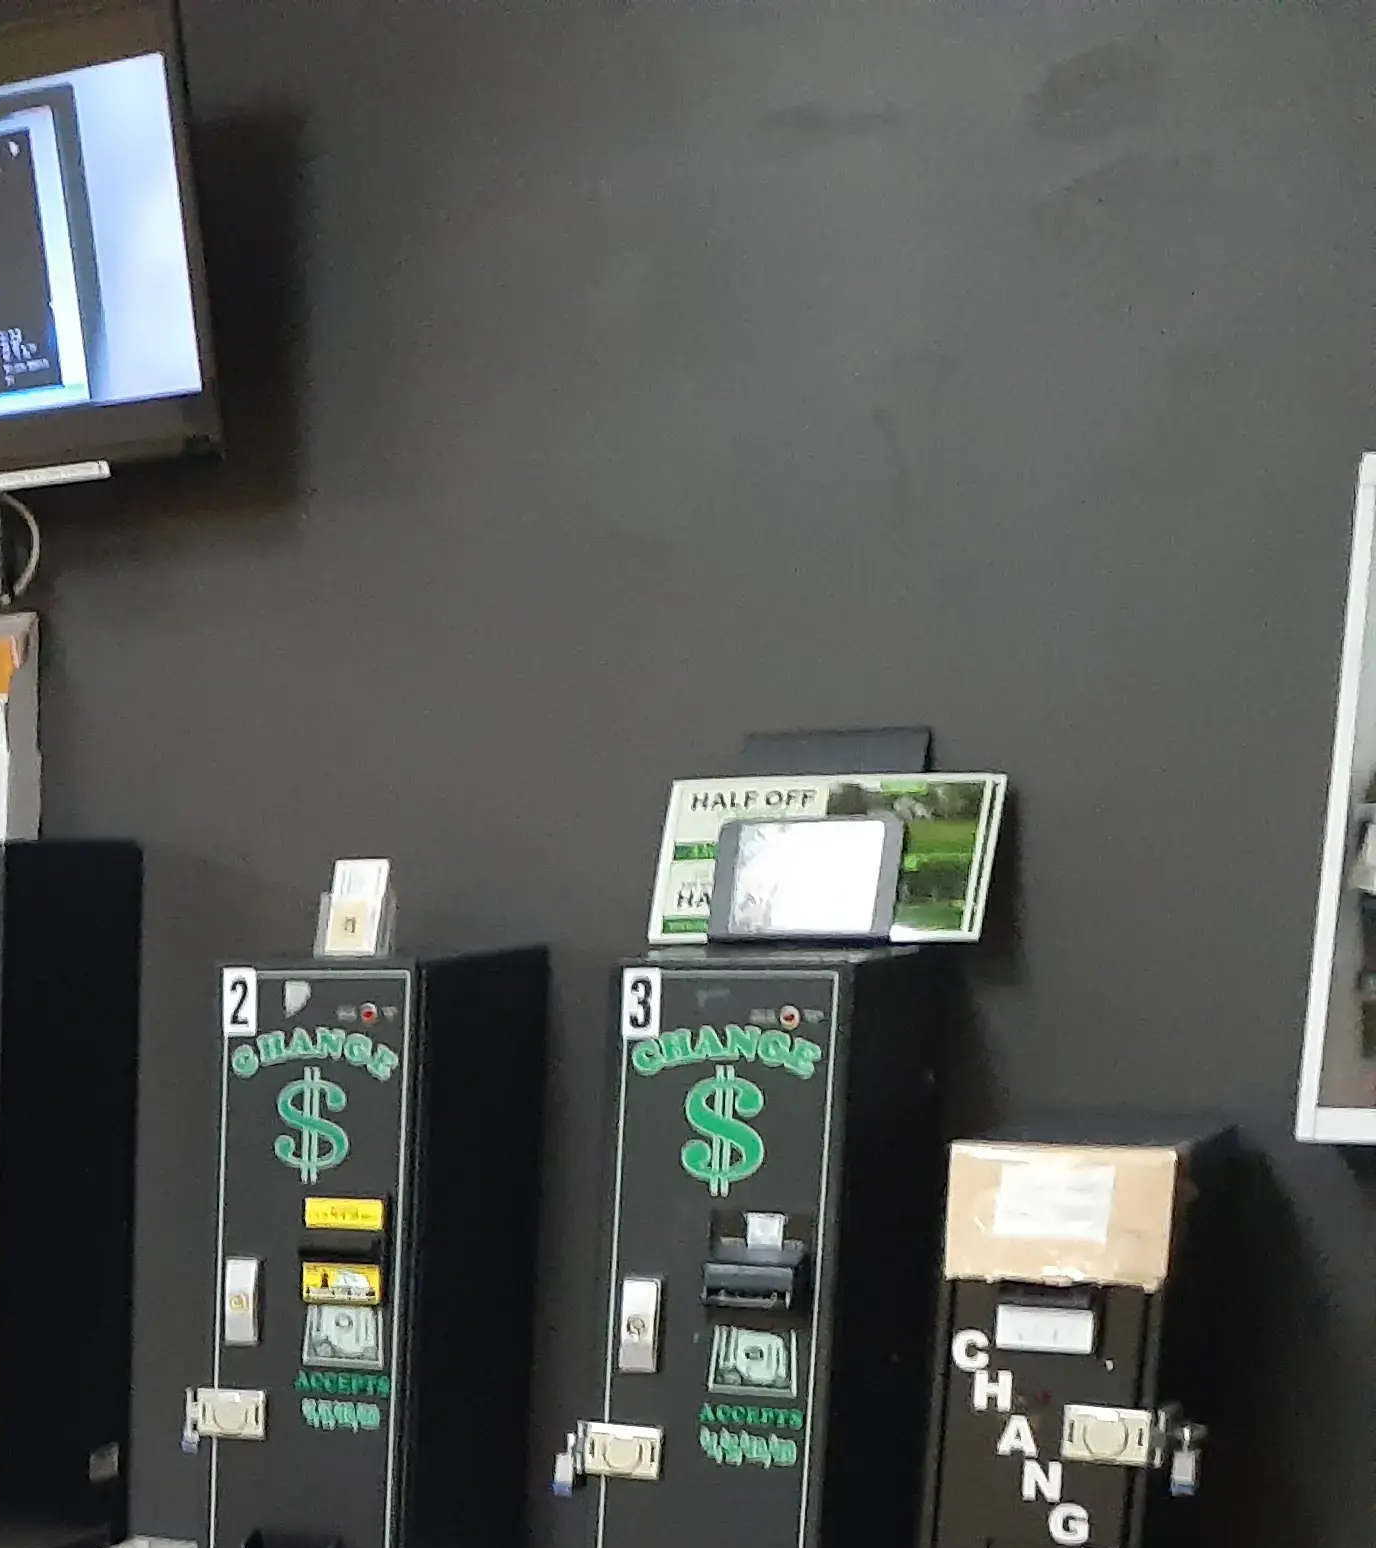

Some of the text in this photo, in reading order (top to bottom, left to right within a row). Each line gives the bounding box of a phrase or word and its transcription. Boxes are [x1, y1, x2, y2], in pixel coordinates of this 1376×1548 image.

[690, 788, 819, 811] HALF OFF
[230, 977, 249, 1026] 2
[629, 976, 653, 1029] 3
[231, 1026, 399, 1081] CHANGE
[631, 1023, 822, 1080] CHANGE
[294, 1368, 391, 1397] ACCEPTS
[699, 1402, 804, 1431] ACCEPTS
